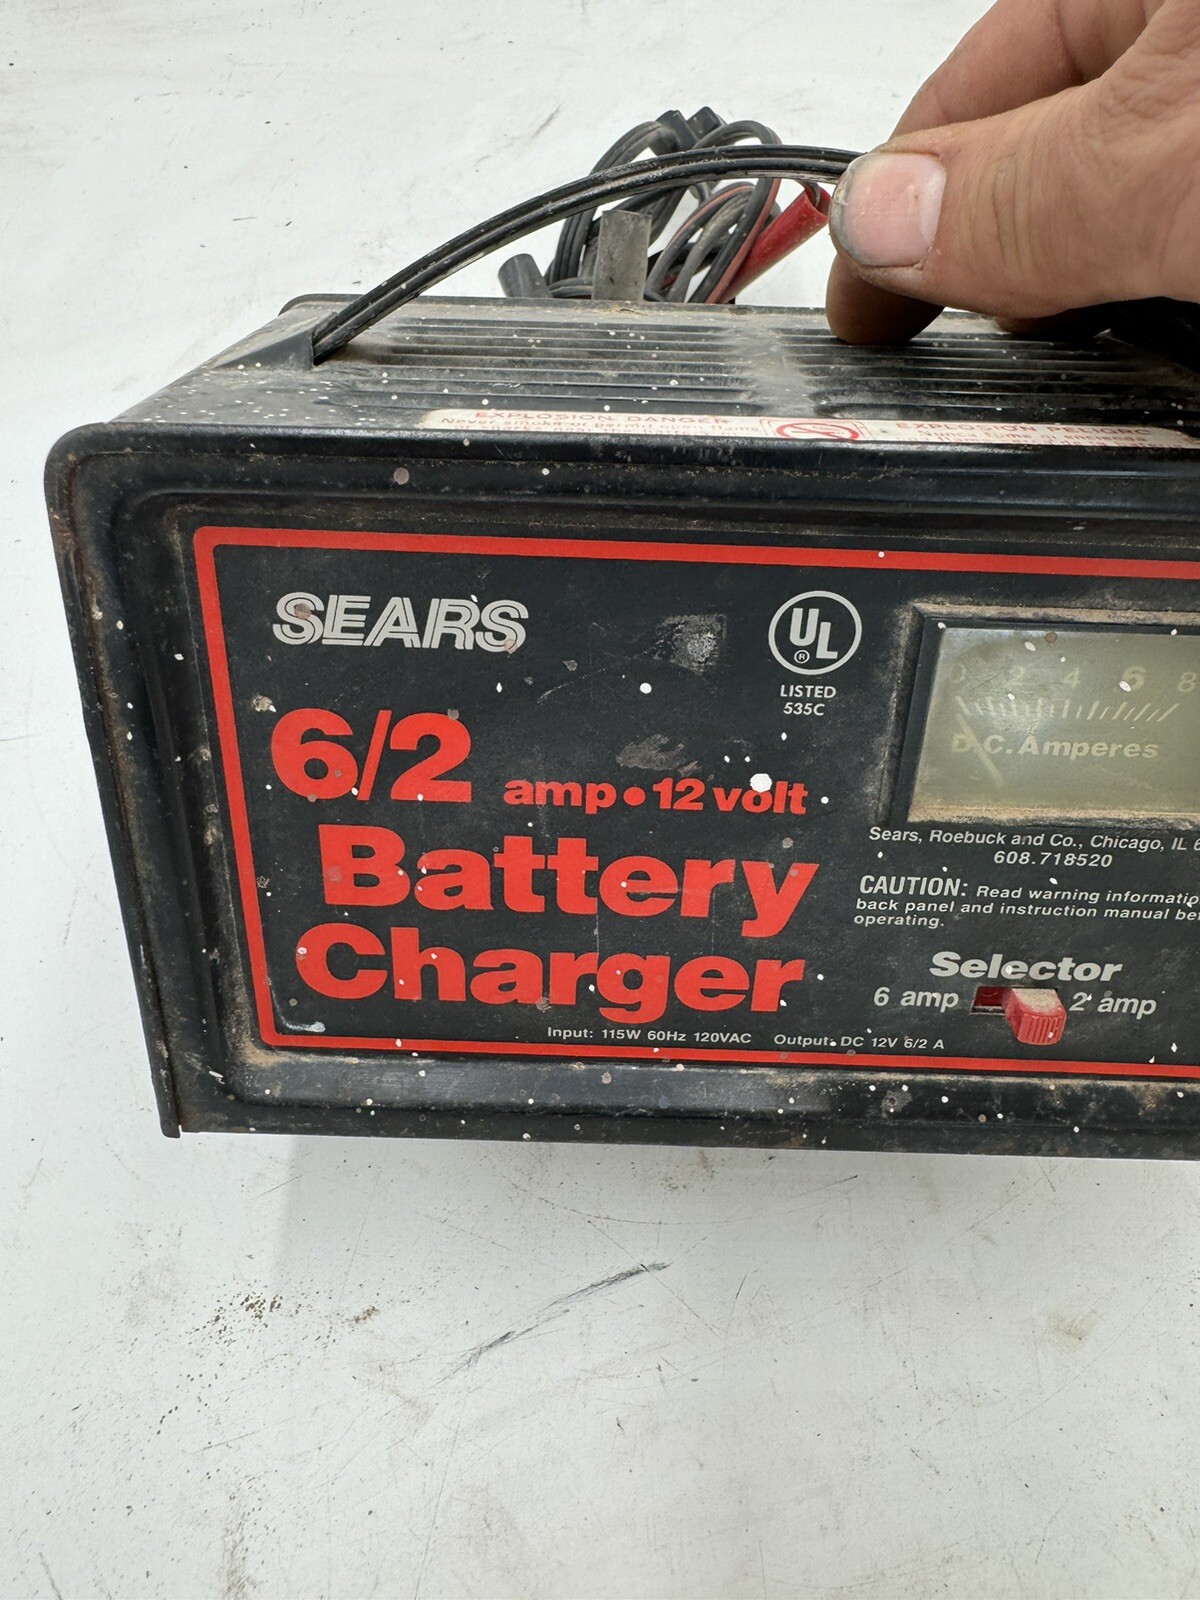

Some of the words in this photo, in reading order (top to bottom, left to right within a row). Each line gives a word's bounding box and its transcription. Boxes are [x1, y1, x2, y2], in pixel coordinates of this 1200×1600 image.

[475, 411, 613, 422] EXPLOSION
[272, 591, 530, 653] SEARS
[780, 684, 837, 700] LISTED
[1120, 665, 1147, 692] 6
[1177, 671, 1198, 693] 8
[783, 701, 826, 717] 535C
[270, 707, 472, 803] 6/2
[1018, 734, 1160, 761] Amperes
[657, 777, 706, 811] 12
[712, 781, 809, 815] volt
[869, 826, 923, 844] Sears,
[929, 829, 1006, 846] Roebuck
[1012, 833, 1044, 847] and
[1050, 834, 1083, 850] Co.,
[1090, 835, 1165, 853] Chicago,
[1171, 837, 1188, 851] IL
[993, 850, 1114, 869] 608.718520
[318, 824, 819, 938] Battery
[859, 875, 968, 897] CAUTION:
[976, 885, 1022, 899] Read
[1028, 889, 1100, 904] warning
[853, 914, 945, 929] operating.
[856, 898, 899, 911] back
[905, 900, 955, 914] panel
[960, 903, 994, 915] and
[1000, 903, 1097, 918] instruction
[1103, 908, 1170, 920] manual
[296, 923, 806, 1024] Charger
[929, 951, 1123, 982] Selector
[873, 986, 890, 1006] 6
[900, 989, 960, 1012] amp
[1069, 991, 1089, 1012] 2
[1097, 996, 1157, 1019] amp
[547, 1026, 594, 1040] Input:
[601, 1029, 642, 1041] 115W
[647, 1030, 687, 1043] 60Hz
[694, 1031, 752, 1045] 120VAC
[774, 1033, 835, 1048] Output:
[840, 1036, 864, 1048] DC
[871, 1037, 899, 1048] 12V
[903, 1038, 929, 1050] 6/2
[933, 1038, 945, 1050] A
